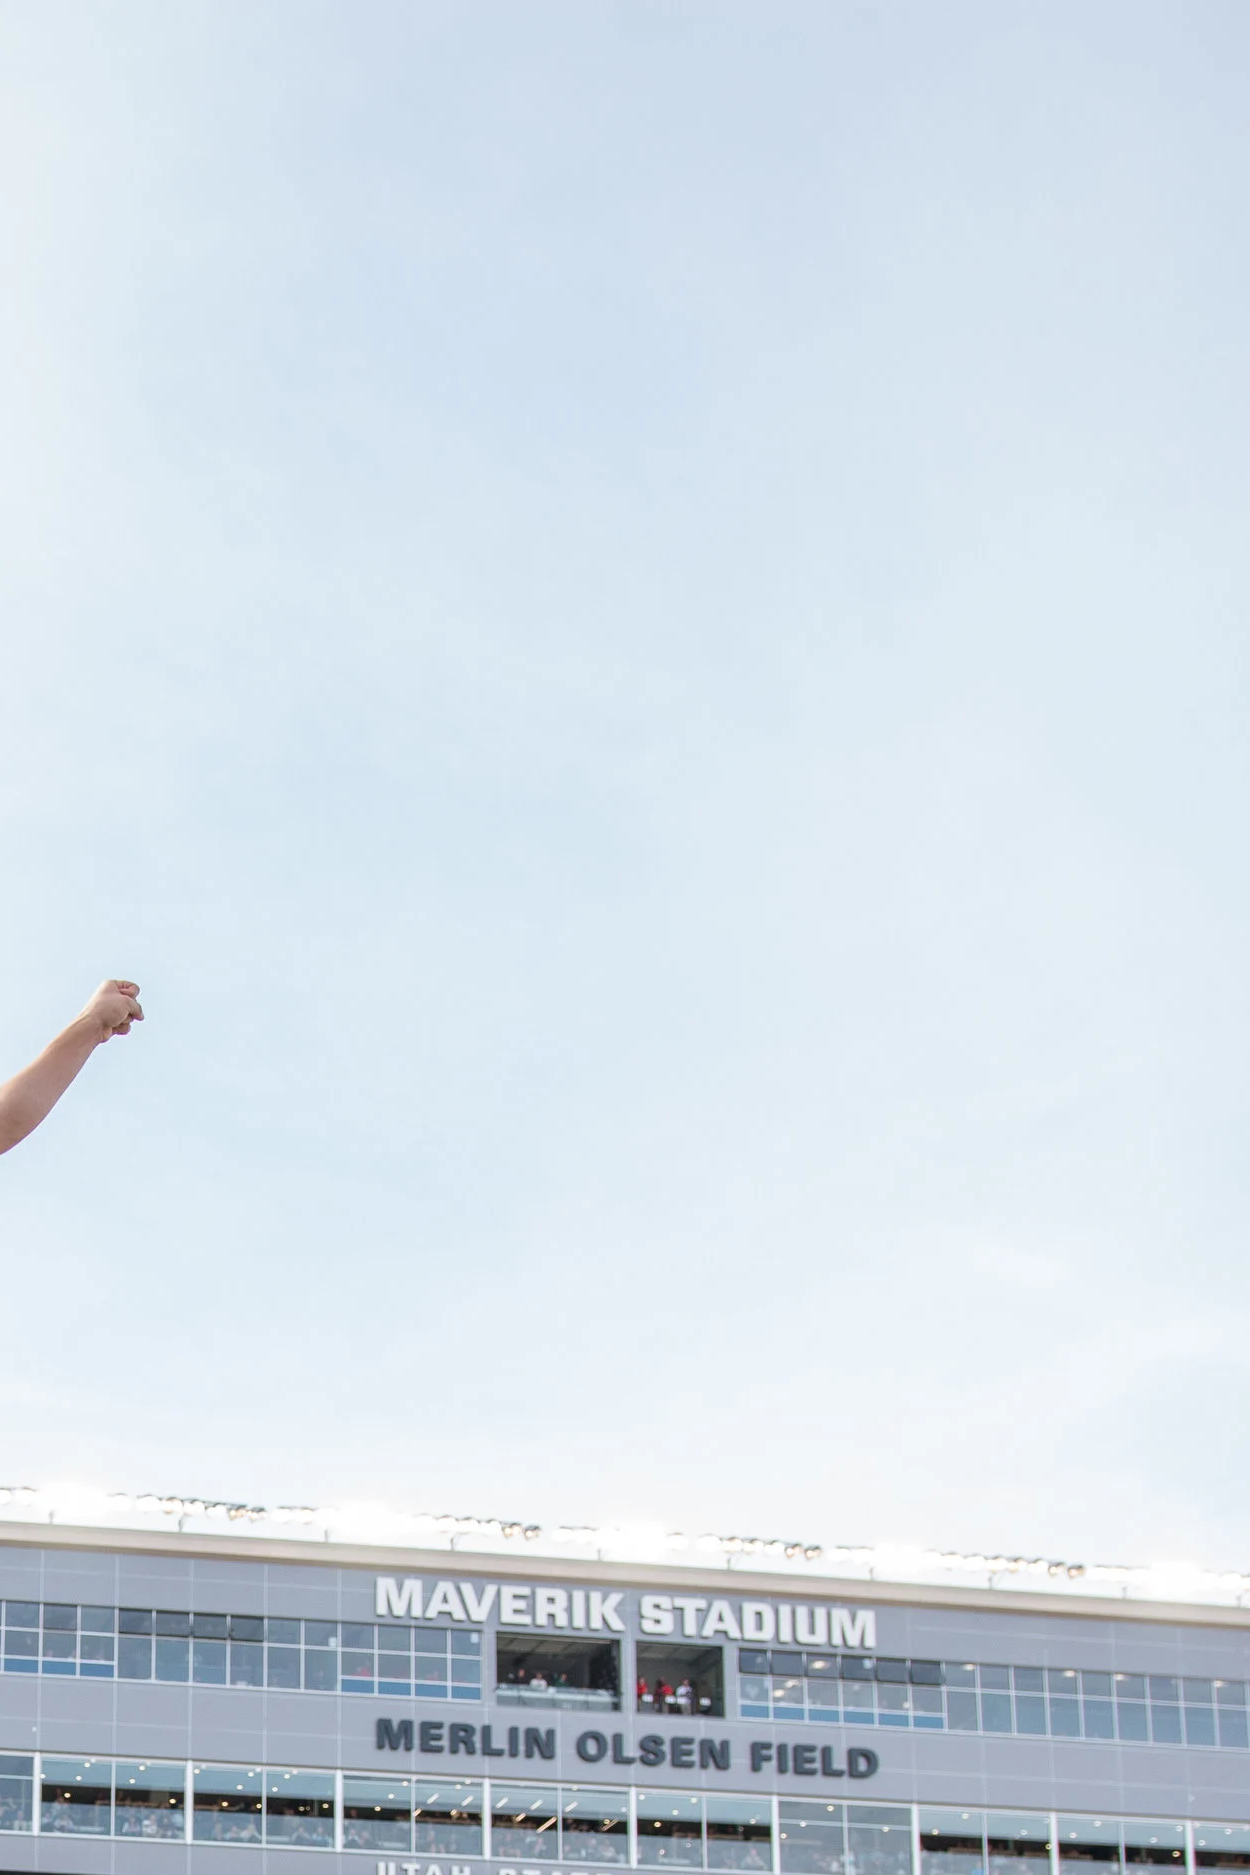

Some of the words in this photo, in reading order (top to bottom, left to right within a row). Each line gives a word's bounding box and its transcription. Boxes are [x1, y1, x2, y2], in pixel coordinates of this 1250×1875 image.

[375, 1575, 627, 1633] MAVERIK
[640, 1595, 876, 1648] STADIUM
[376, 1717, 556, 1761] MERLIN
[576, 1729, 731, 1771] OLSEN
[751, 1741, 880, 1780] FIELD
